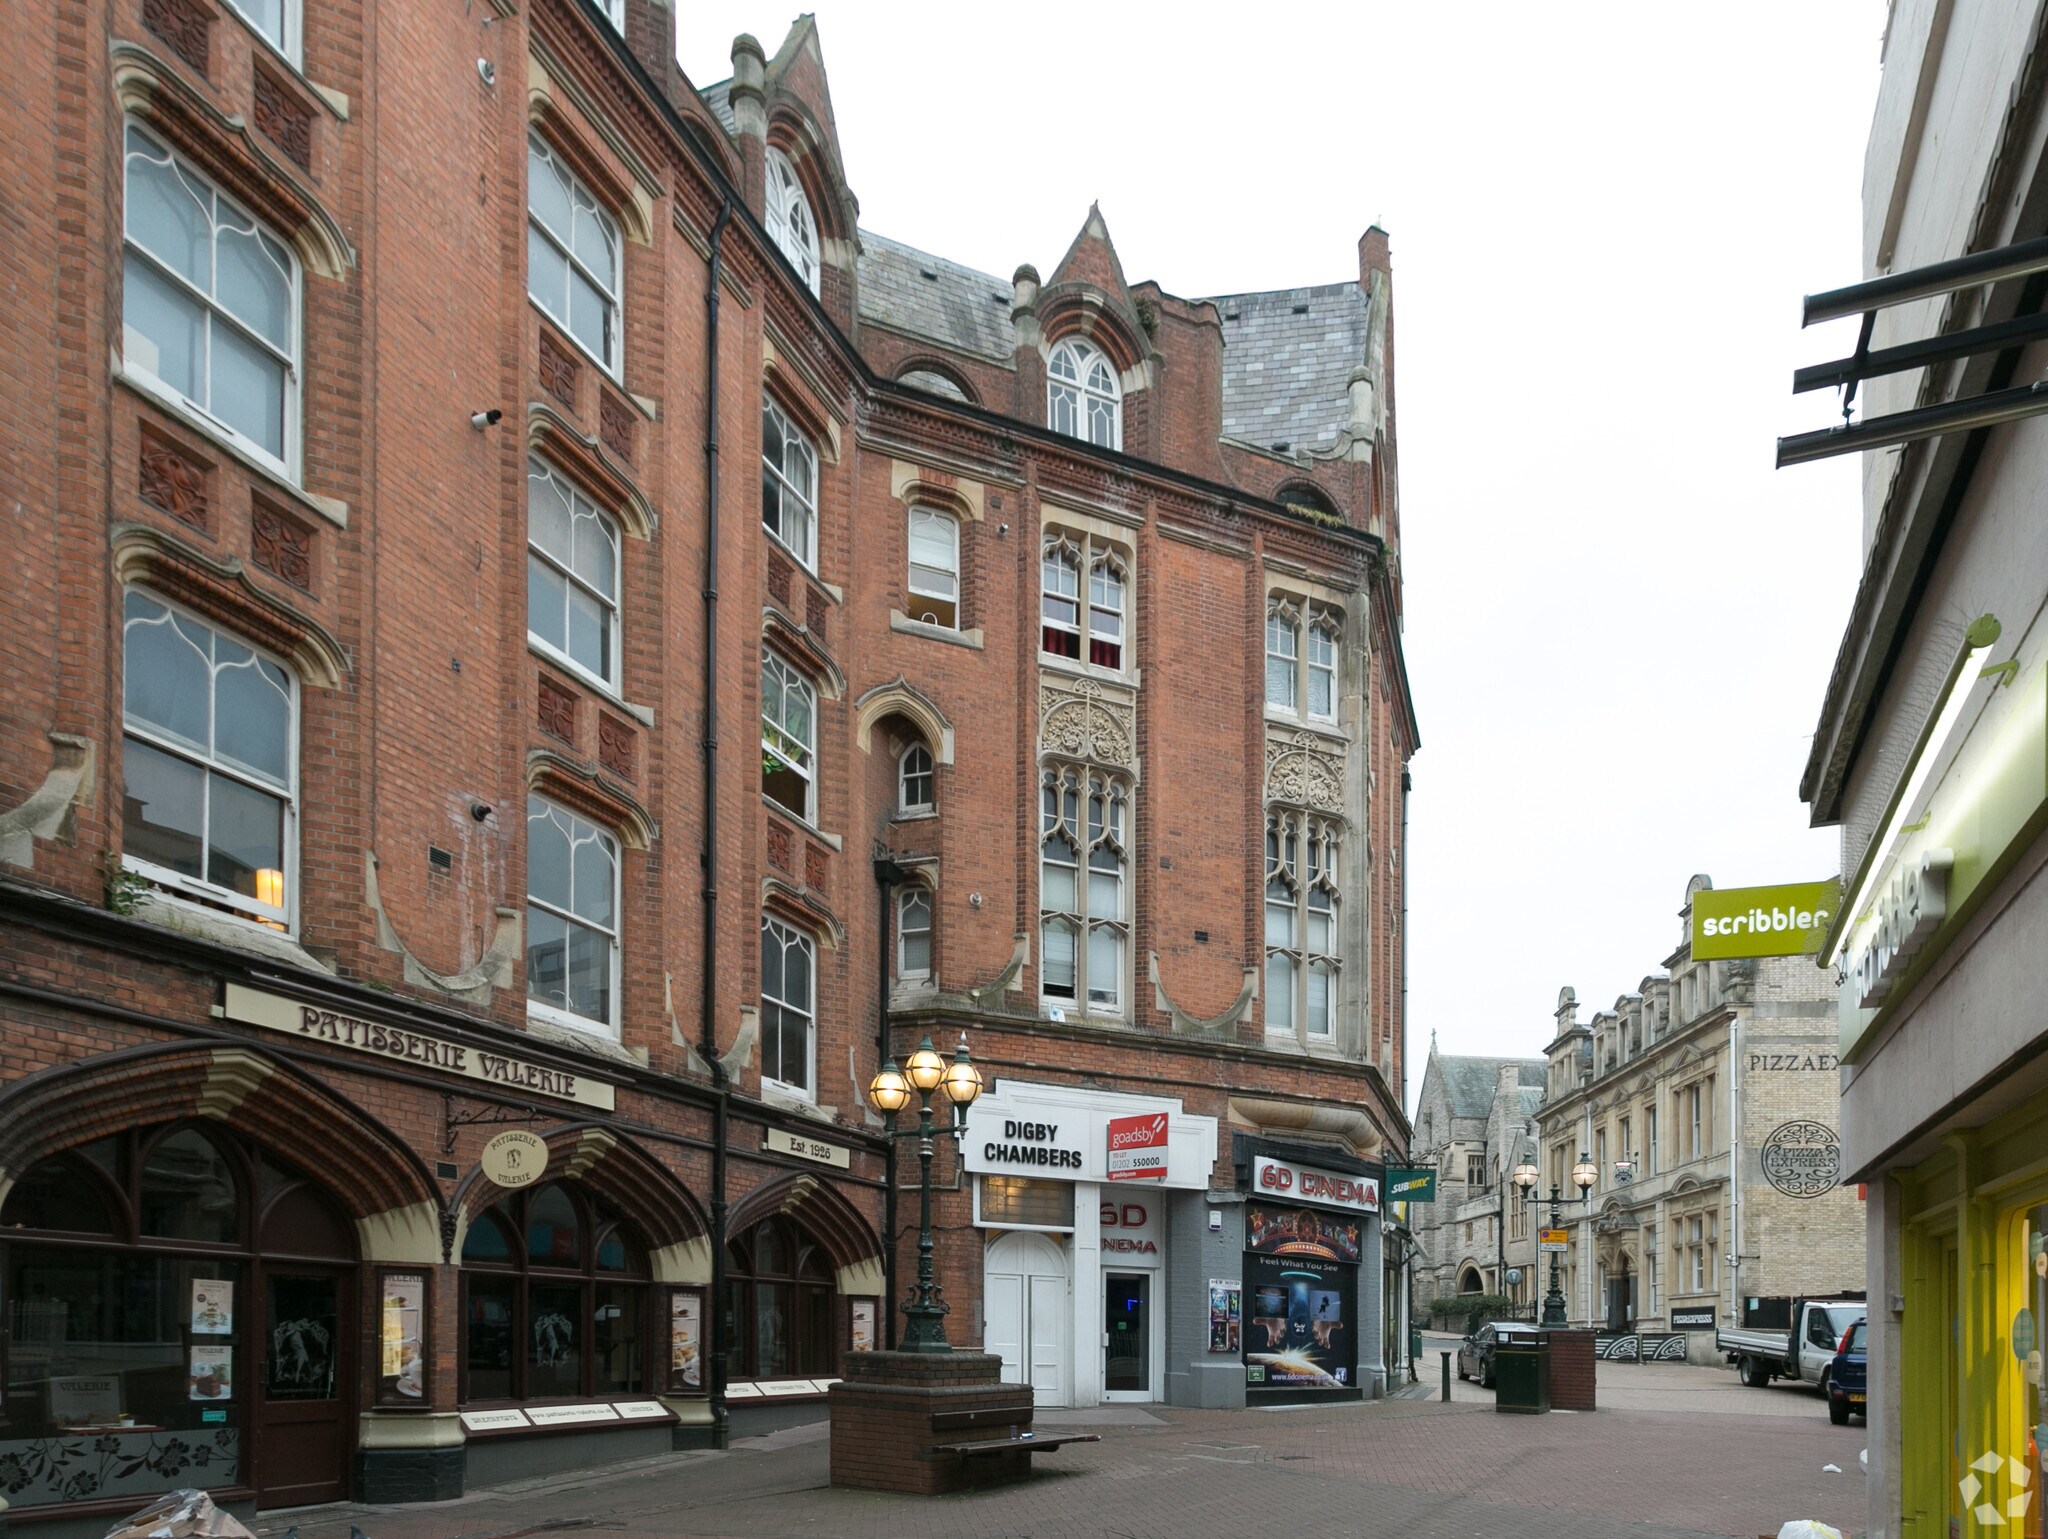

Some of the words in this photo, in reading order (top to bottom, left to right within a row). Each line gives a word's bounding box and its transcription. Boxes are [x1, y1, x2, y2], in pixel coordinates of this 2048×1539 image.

[1702, 905, 1829, 937] scribbler
[299, 1005, 467, 1071] PATISSERIE
[477, 1053, 576, 1097] VALERIE
[1004, 1119, 1058, 1142] DIGBY
[1112, 1124, 1155, 1149] goadsby
[491, 1133, 538, 1151] PATISSERIE
[790, 1137, 808, 1154] Est.
[810, 1143, 831, 1160] 1926
[984, 1142, 1082, 1168] CHAMBERS
[1770, 1157, 1837, 1168] EXPRESS
[1782, 1147, 1824, 1158] PIZZA
[1112, 1159, 1130, 1169] 01202
[1133, 1157, 1160, 1167] 550000
[498, 1171, 531, 1184] VALERIE
[1112, 1171, 1136, 1179] goadsby.com
[1261, 1164, 1293, 1189] 6D
[1300, 1171, 1378, 1206] CINEMA
[1391, 1176, 1430, 1194] SUBWAY
[1100, 1202, 1147, 1228] 6D
[1260, 1257, 1279, 1266] Feel
[1280, 1259, 1304, 1268] What
[1305, 1261, 1322, 1270] You
[1323, 1263, 1338, 1272] See
